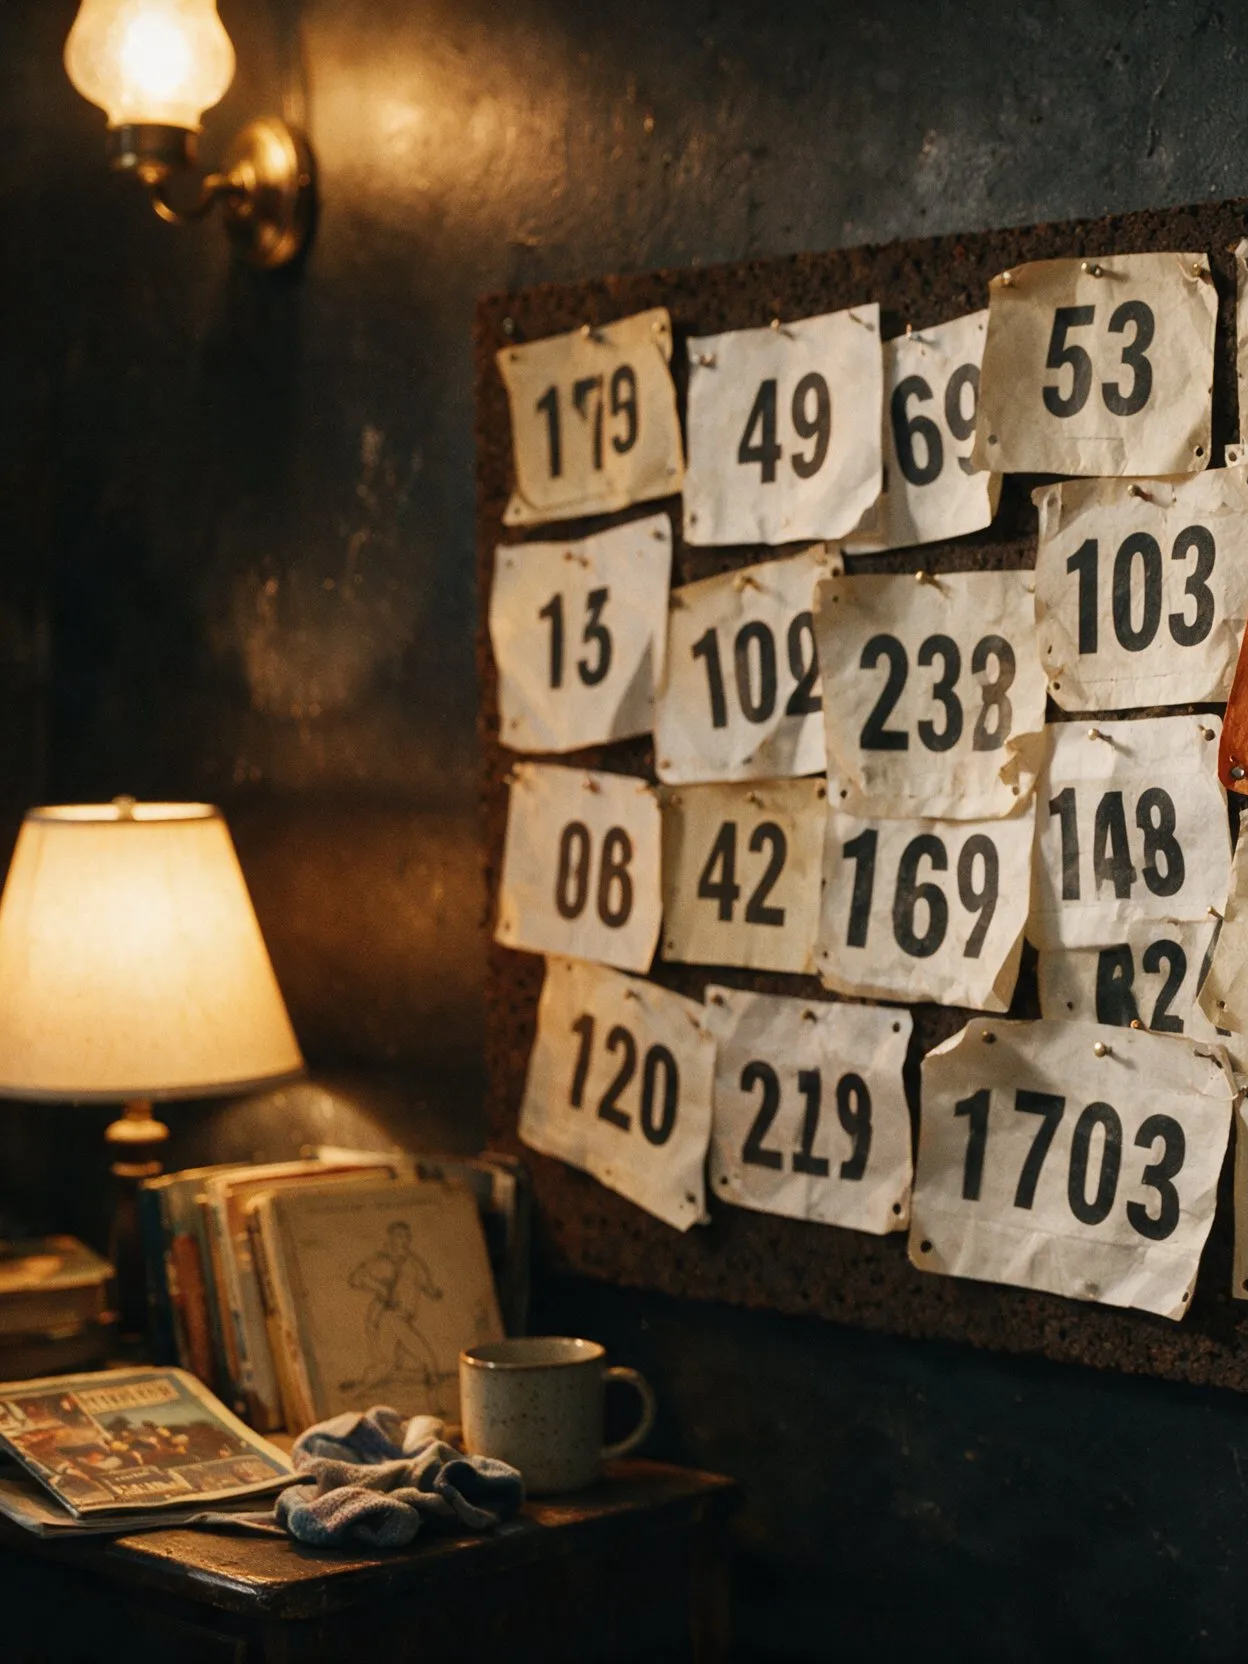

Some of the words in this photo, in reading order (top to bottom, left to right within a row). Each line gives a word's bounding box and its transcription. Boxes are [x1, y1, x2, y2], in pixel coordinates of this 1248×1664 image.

[1041, 300, 1155, 418] 53
[737, 371, 832, 484] 49
[890, 362, 981, 486] 69
[1066, 524, 1216, 656] 103
[697, 820, 788, 927] 42
[841, 828, 999, 959] 169
[568, 1013, 680, 1147] 120
[740, 1060, 873, 1181] 219
[952, 1087, 1187, 1241] 1703
